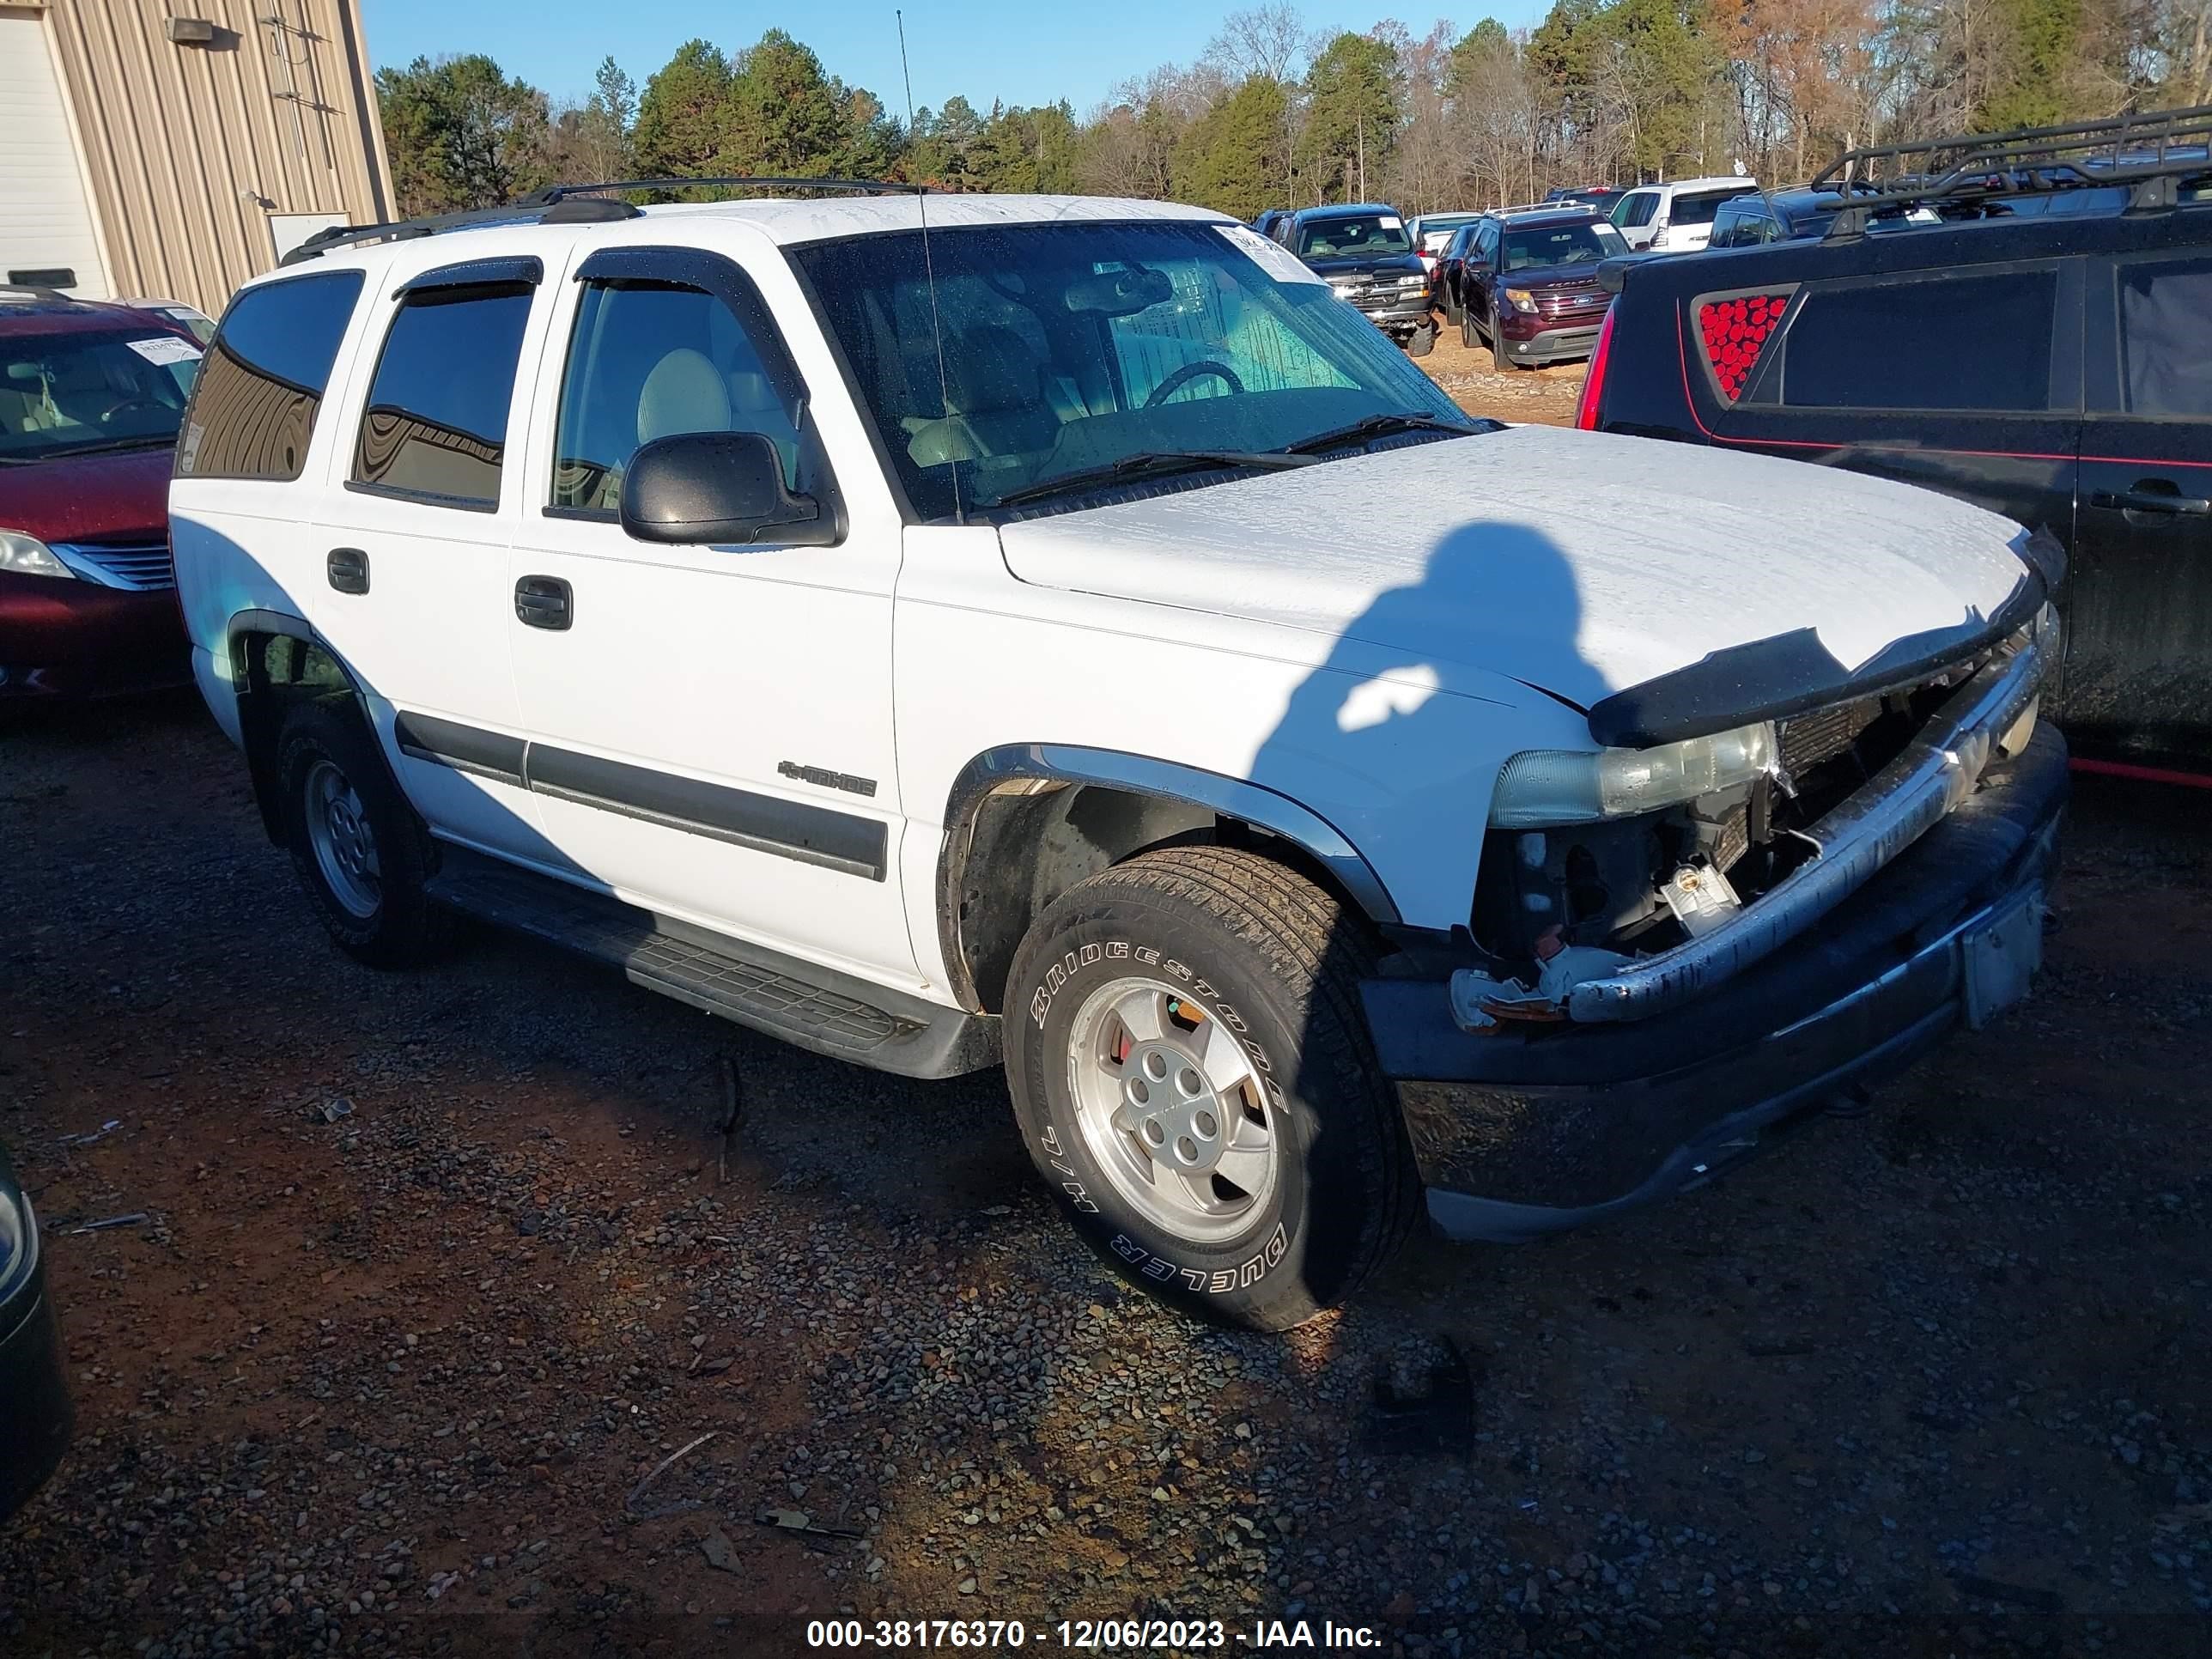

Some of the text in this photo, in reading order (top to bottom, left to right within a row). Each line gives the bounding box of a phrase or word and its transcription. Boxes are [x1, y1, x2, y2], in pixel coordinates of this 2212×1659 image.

[804, 765, 877, 797] TAHOE
[1030, 941, 1291, 1115] BRIDGESTONE
[1041, 1127, 1291, 1293] DUELER H/L
